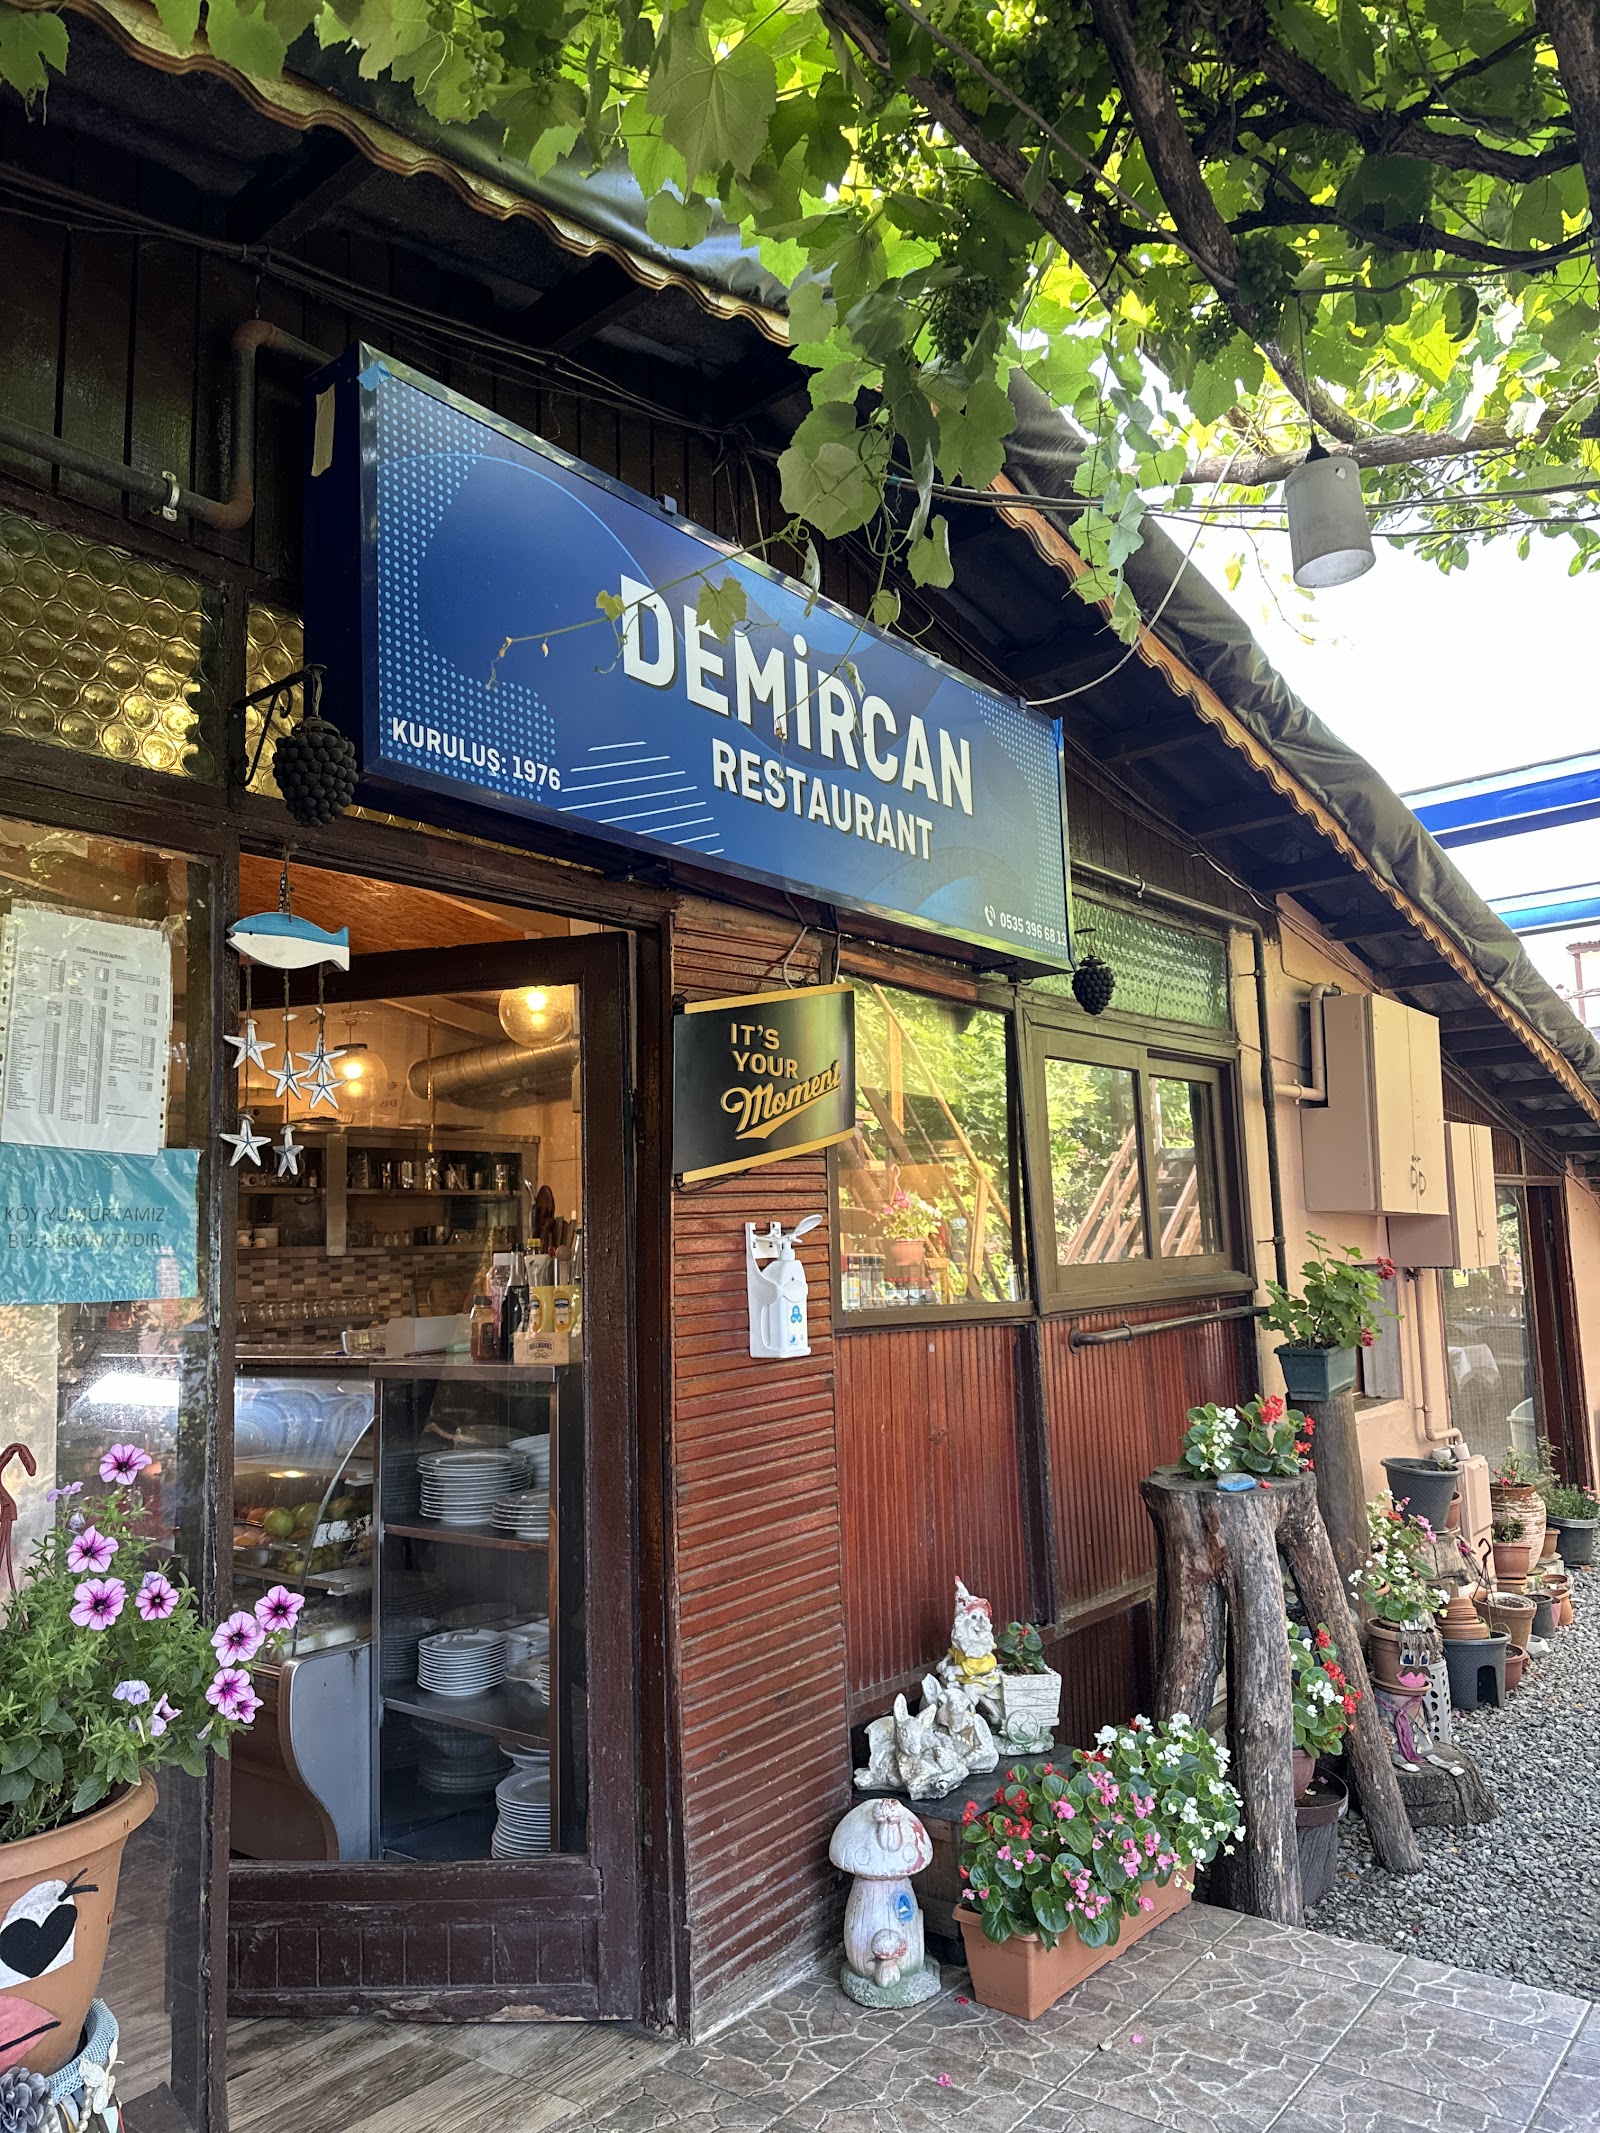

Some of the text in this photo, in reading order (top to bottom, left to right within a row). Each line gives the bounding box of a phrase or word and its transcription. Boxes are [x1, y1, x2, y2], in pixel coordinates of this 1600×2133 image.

[392, 717, 561, 791] KURULUŞ: 1976
[712, 738, 933, 860] RESTAURANT
[1000, 912, 1067, 947] 0535 396 68 13
[731, 1023, 780, 1050] IT'S
[732, 1050, 799, 1079] YOUR
[721, 1059, 842, 1132] Moment
[4, 1203, 165, 1222] KÖY YUMURTAMIZ
[8, 1233, 161, 1248] BULUNMAKTADIR
